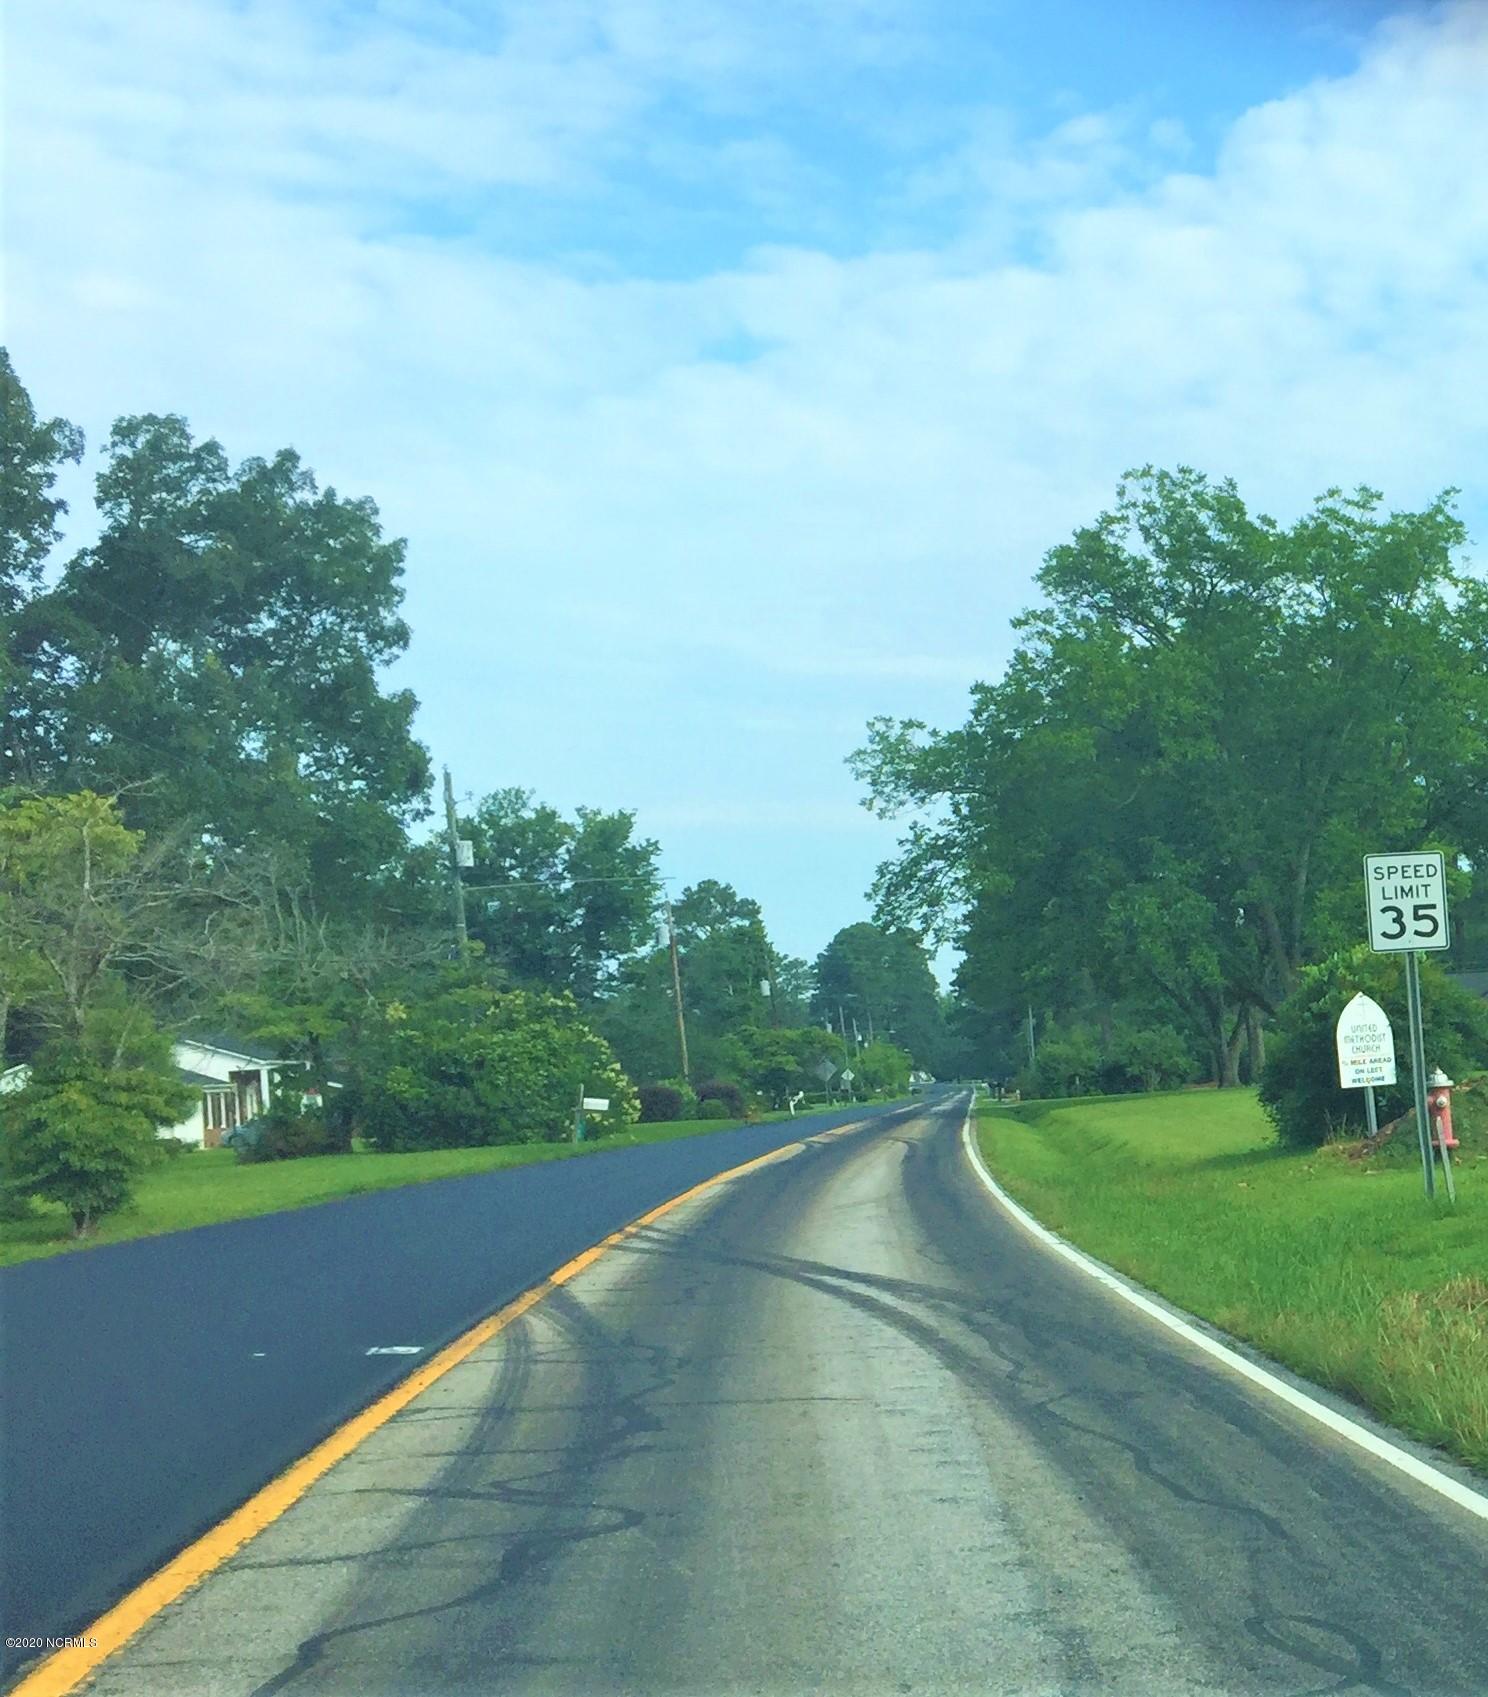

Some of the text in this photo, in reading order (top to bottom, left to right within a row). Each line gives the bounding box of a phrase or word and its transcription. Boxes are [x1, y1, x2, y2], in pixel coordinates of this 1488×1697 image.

[1373, 864, 1437, 881] SPEED
[1381, 884, 1431, 900] LIMIT
[1380, 903, 1439, 940] 35
[1351, 1024, 1377, 1034] UNITED
[1344, 1033, 1386, 1044] METHODIST
[1352, 1044, 1380, 1054] CHURCH
